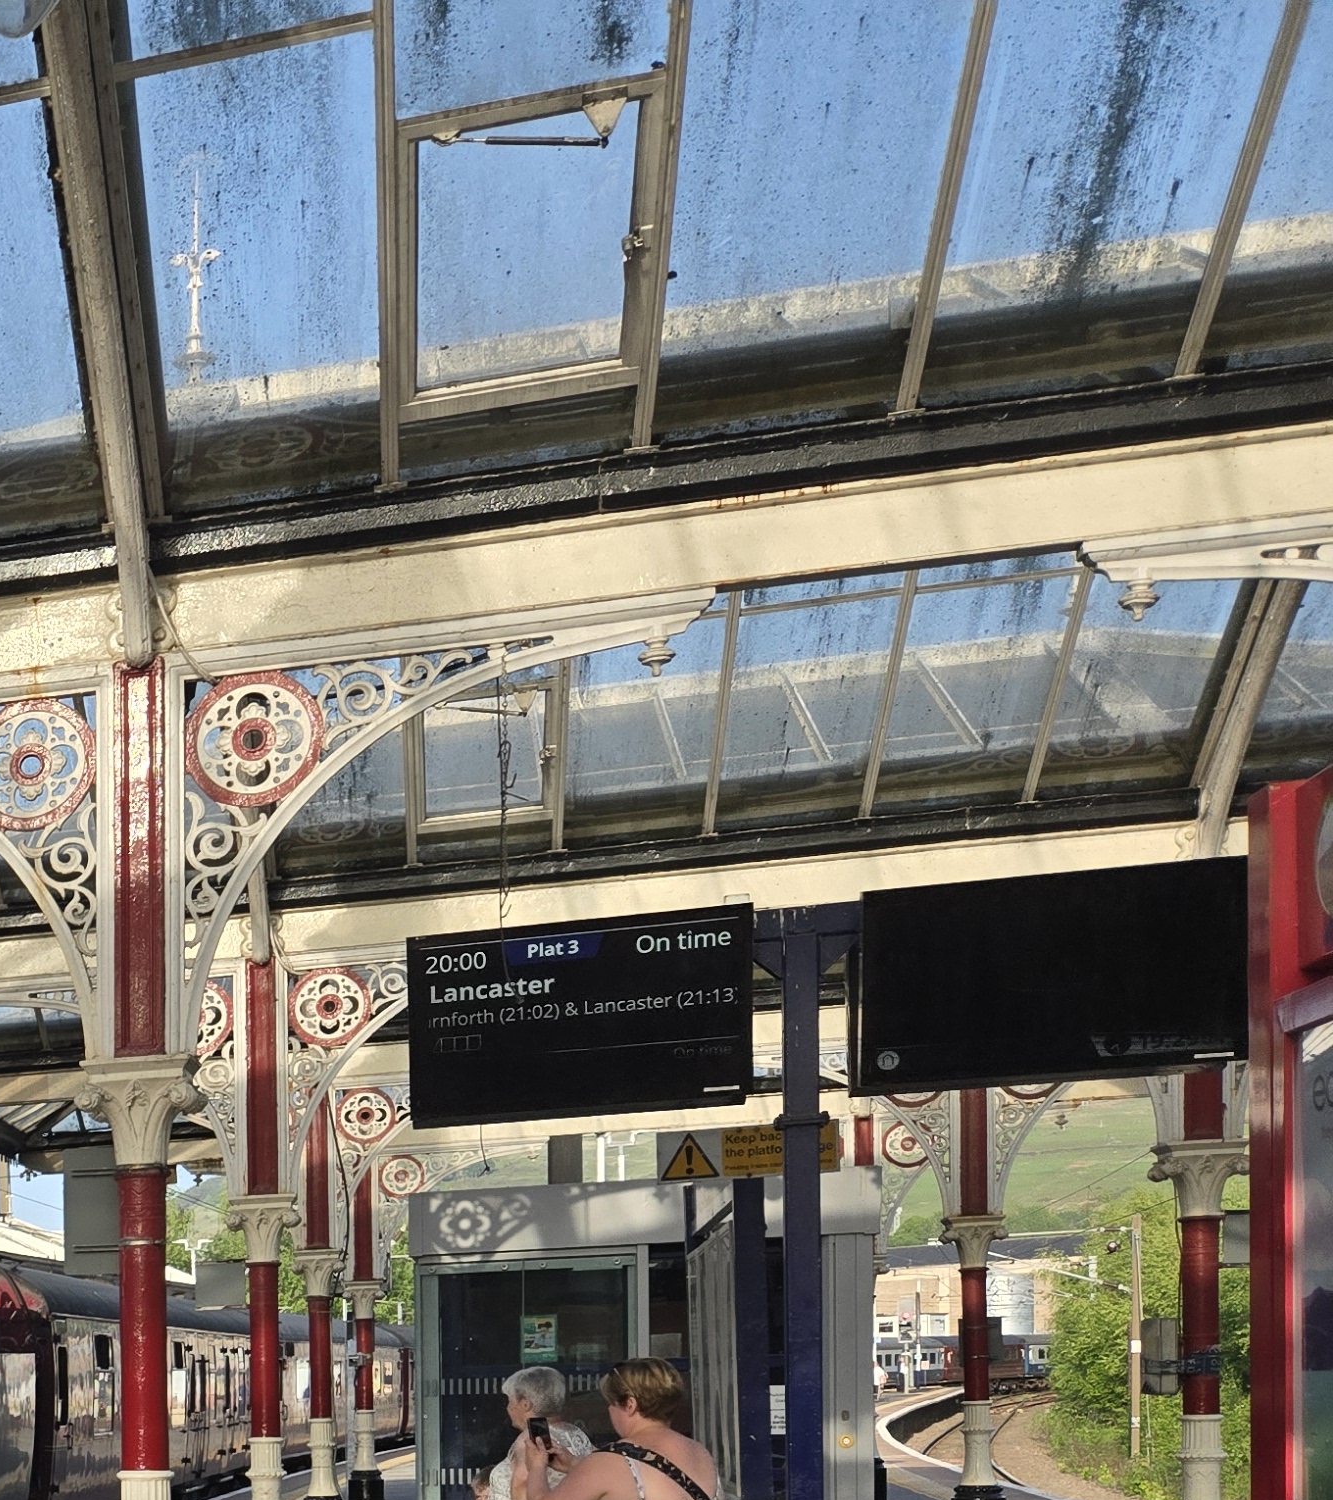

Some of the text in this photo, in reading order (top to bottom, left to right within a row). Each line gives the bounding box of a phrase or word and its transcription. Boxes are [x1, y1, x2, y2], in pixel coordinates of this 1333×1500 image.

[425, 929, 732, 975] 20:00 Plat 3 On time
[430, 975, 556, 1004] Lancaster
[499, 1003, 560, 1025] (21:02)
[564, 1001, 579, 1017] &
[583, 991, 673, 1016] Lancaster
[724, 1131, 783, 1145] Keep bac
[724, 1141, 833, 1158] the platfo ge
